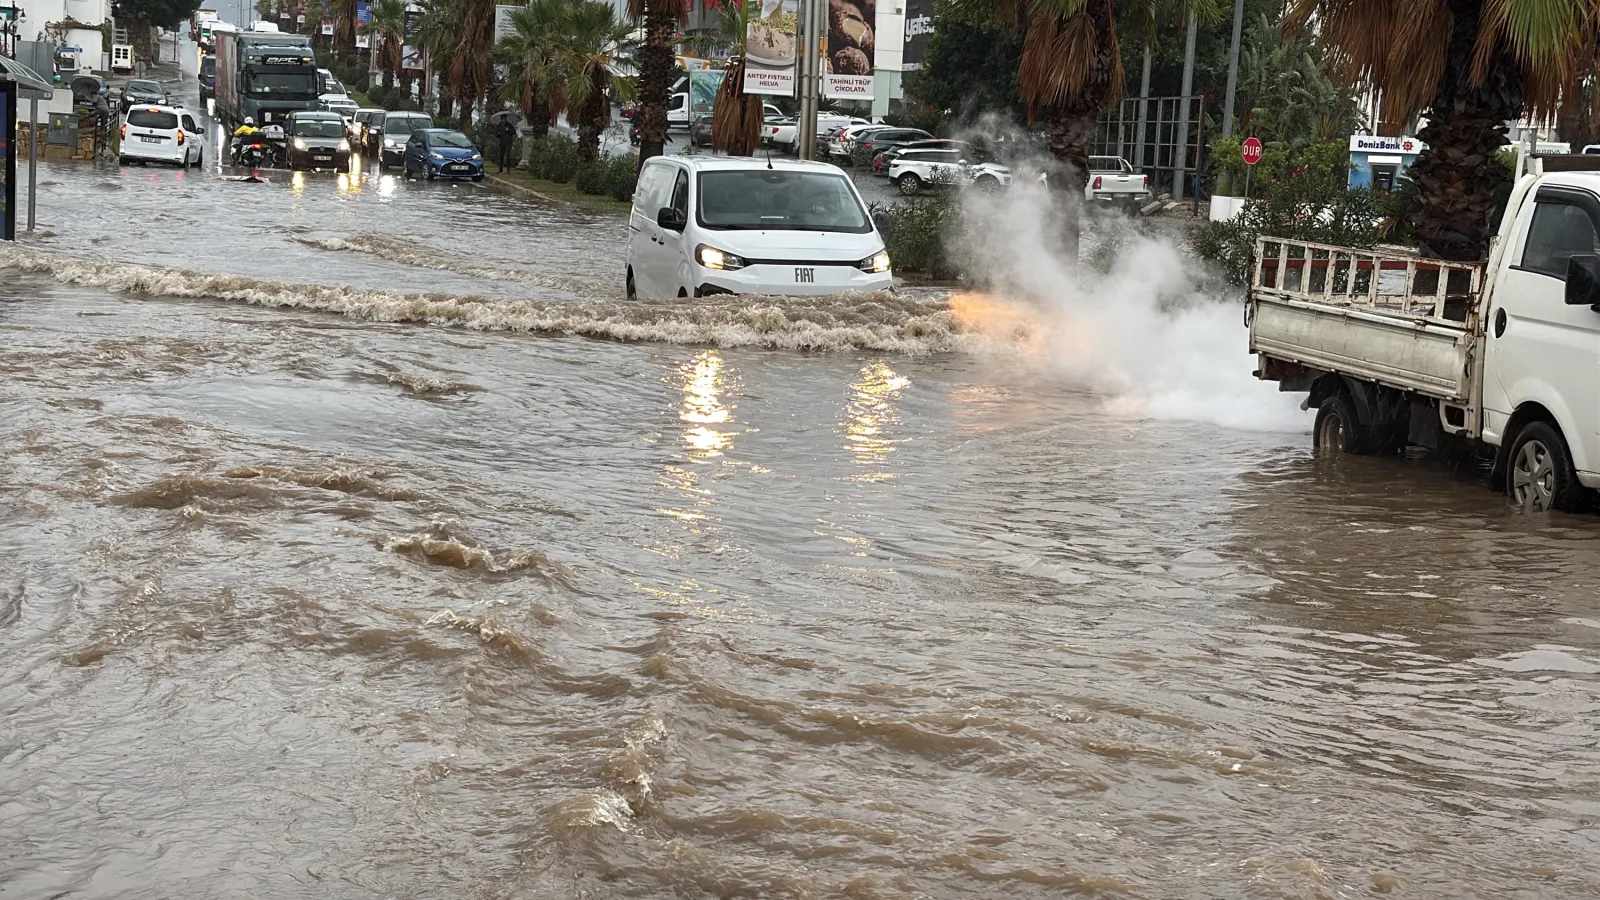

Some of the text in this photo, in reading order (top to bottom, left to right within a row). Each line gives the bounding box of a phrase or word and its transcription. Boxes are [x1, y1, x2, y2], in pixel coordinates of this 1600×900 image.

[829, 77, 854, 85] TAHİNLİ
[834, 85, 866, 93] ÇİKOLATA
[1357, 140, 1401, 150] DenizBank
[1243, 145, 1260, 157] DUR
[795, 267, 814, 283] FIAT
